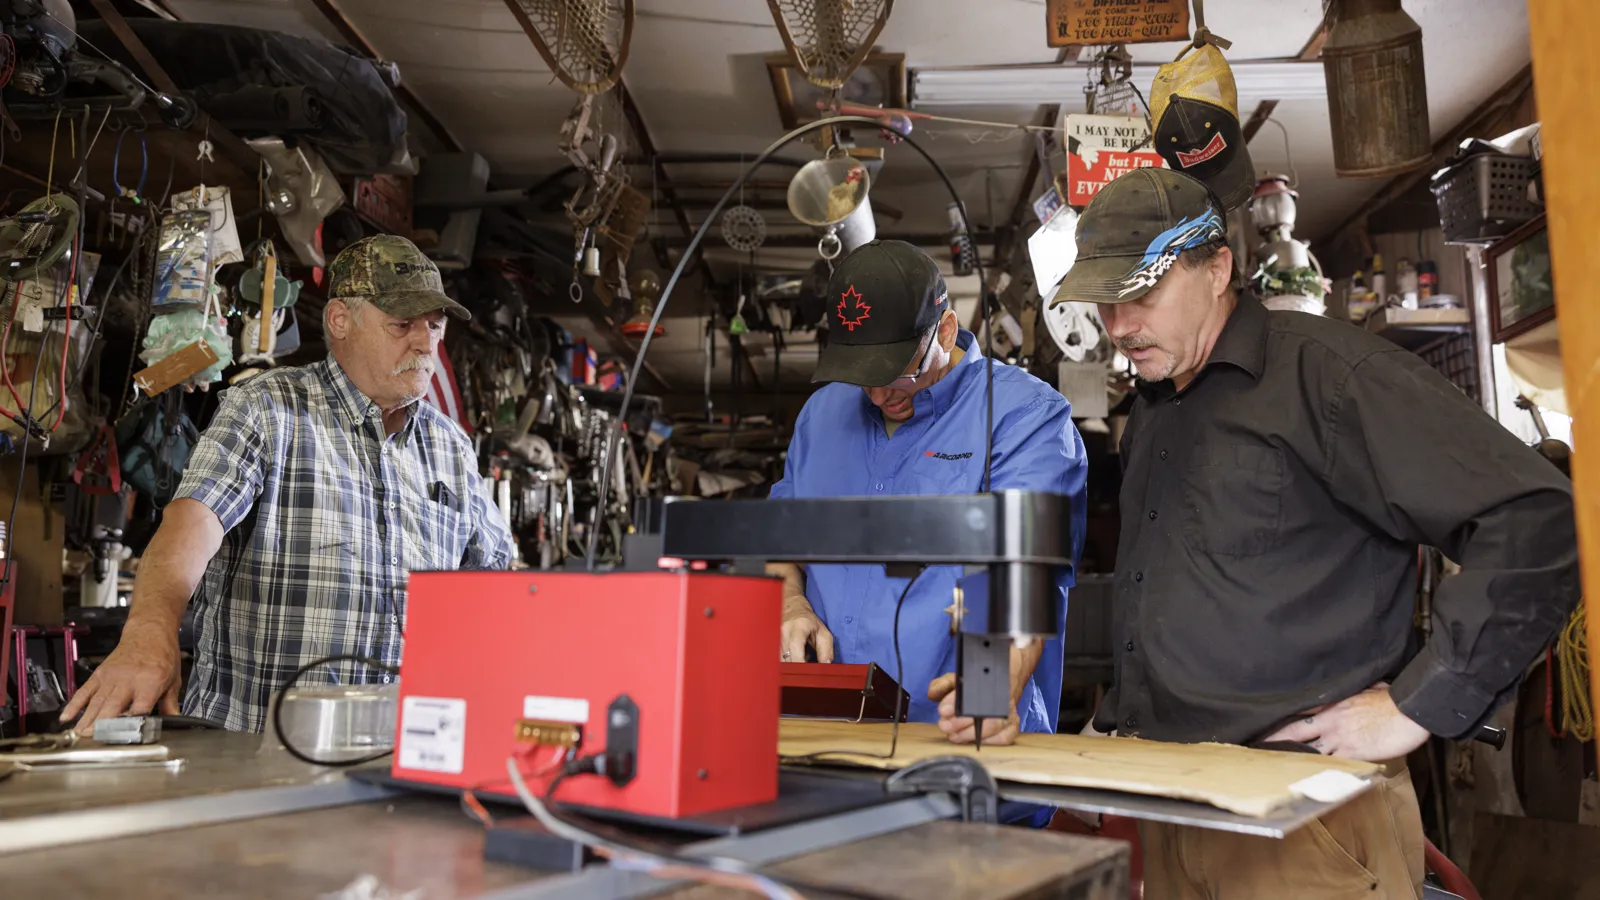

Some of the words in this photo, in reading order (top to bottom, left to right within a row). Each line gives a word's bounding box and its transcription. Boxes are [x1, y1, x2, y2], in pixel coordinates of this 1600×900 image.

[1076, 125, 1081, 135] I
[1085, 125, 1110, 136] MAY
[1114, 127, 1137, 137] NOT
[1104, 138, 1118, 148] BE
[1183, 141, 1220, 163] Budweiser
[1108, 154, 1130, 167] but
[1133, 156, 1154, 168] I'm
